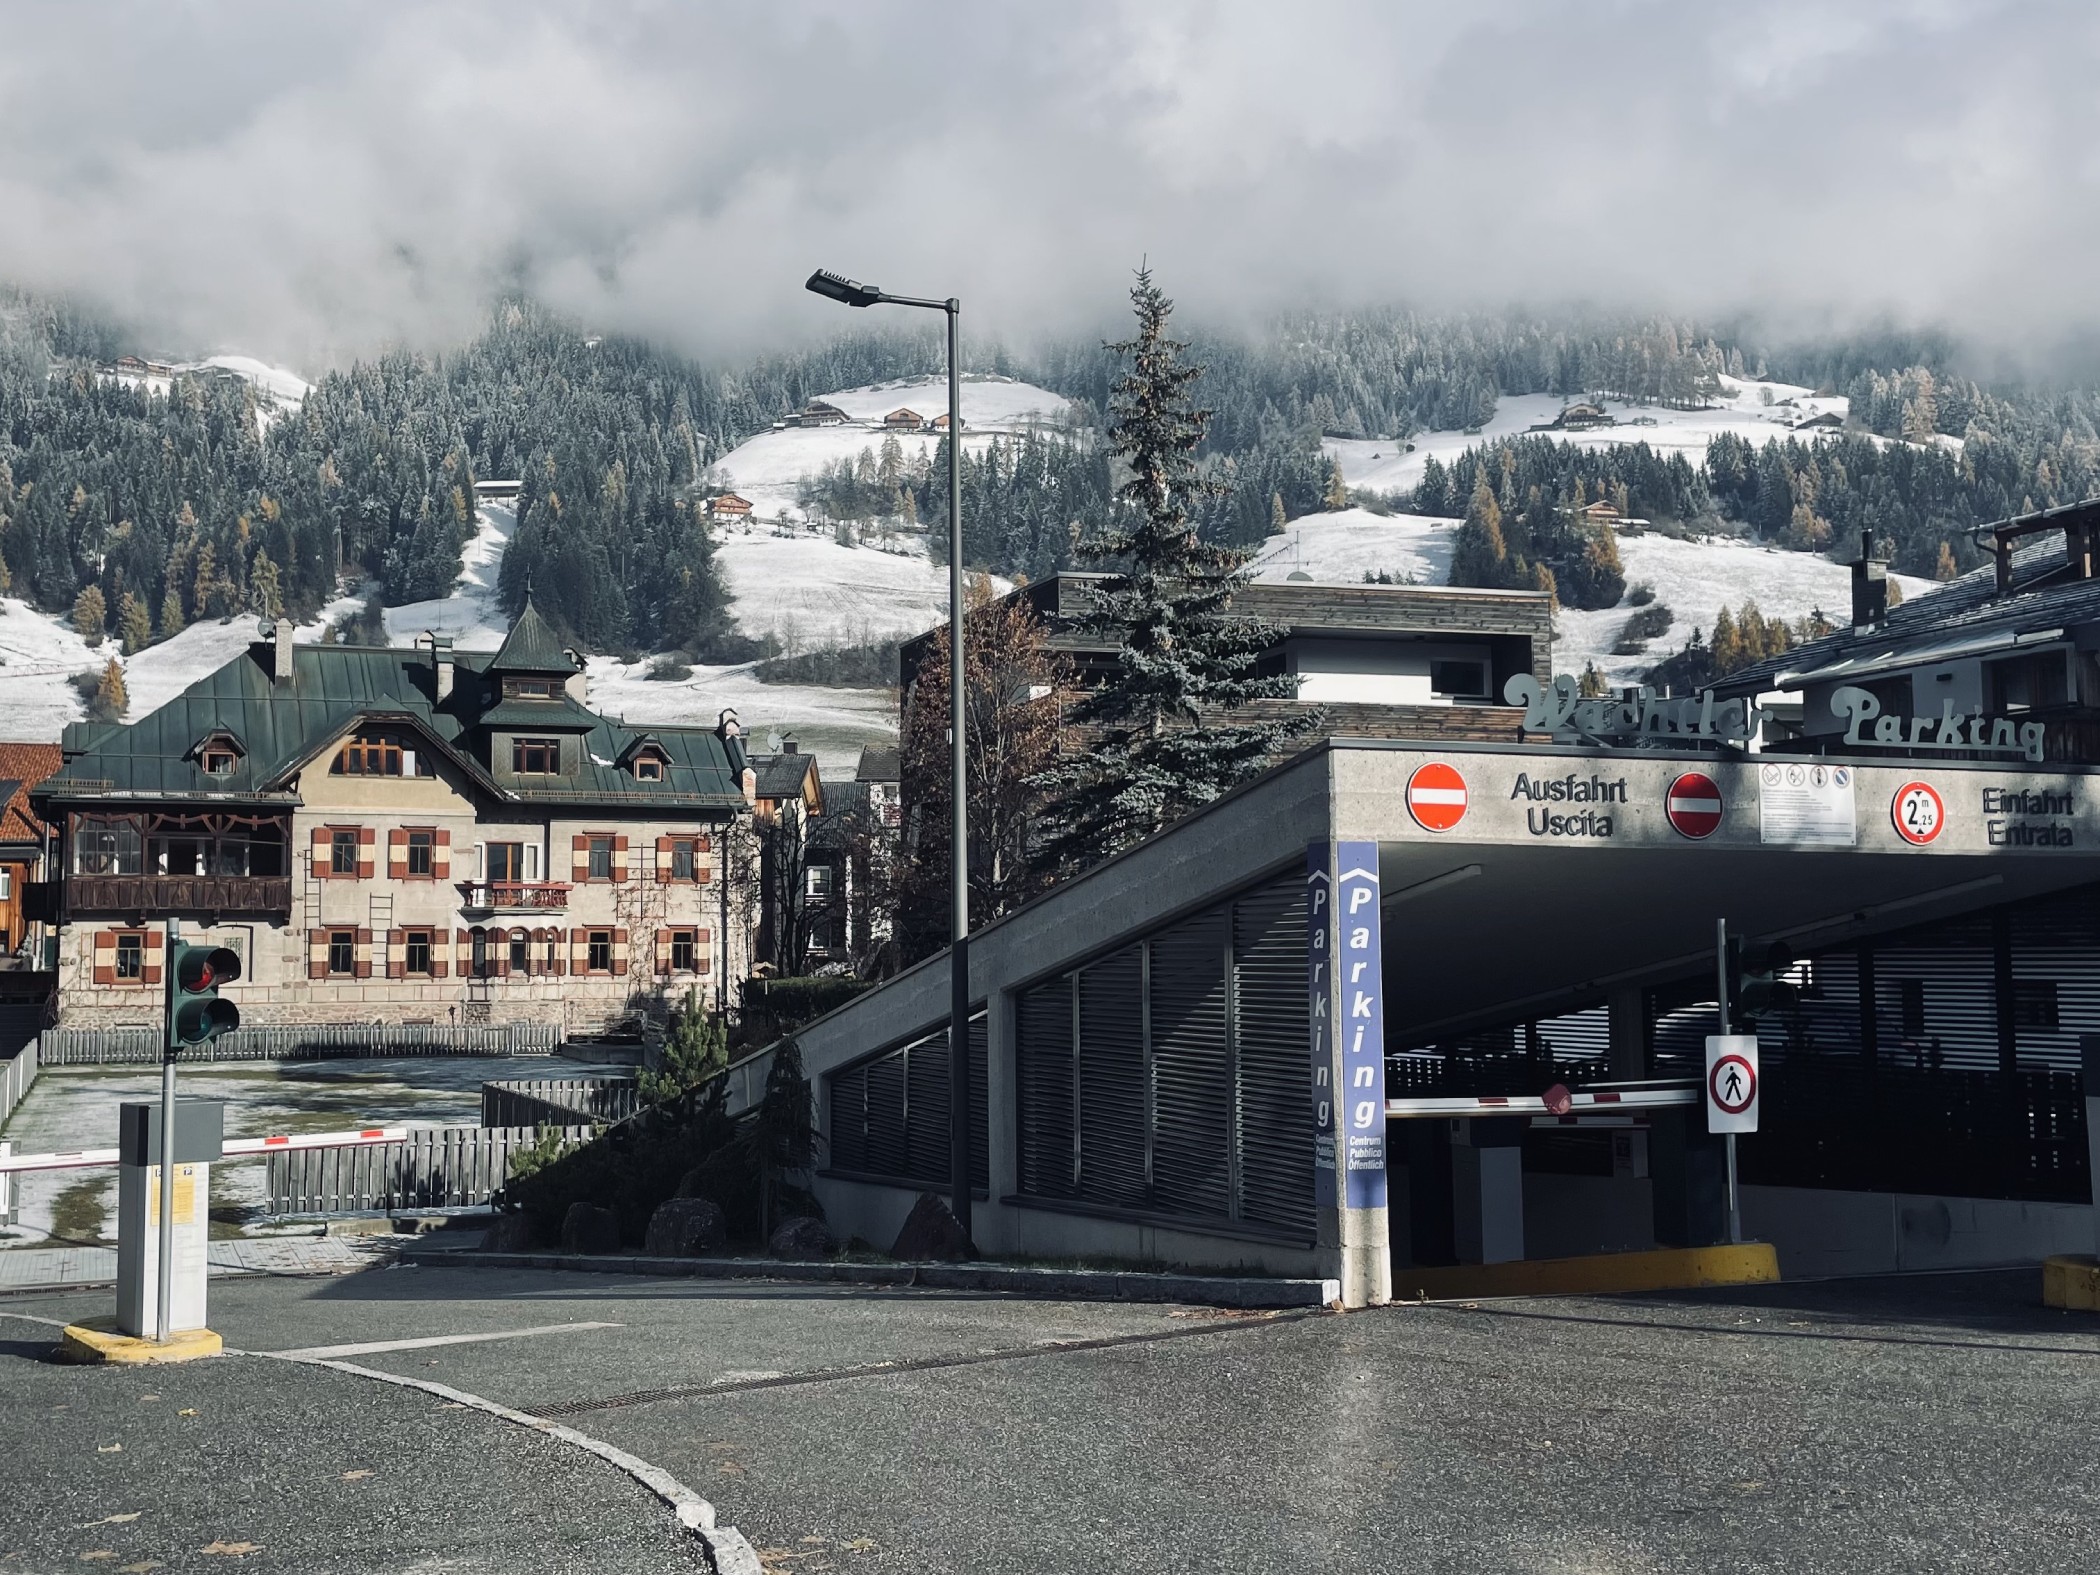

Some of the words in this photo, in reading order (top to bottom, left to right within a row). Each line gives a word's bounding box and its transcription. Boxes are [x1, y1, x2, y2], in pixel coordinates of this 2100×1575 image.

[1830, 686, 2045, 762] Parking
[1511, 773, 1628, 803] Ausfahrt
[1983, 787, 2074, 816] Einfahrt
[1527, 807, 1613, 837] Uscita
[1907, 799, 1918, 825] 2
[1921, 799, 1930, 808] m
[1988, 819, 2073, 847] Entrata
[1313, 888, 1330, 1128] Parking
[1349, 887, 1376, 1129] Parking
[1349, 1135, 1382, 1146] Centrum
[1349, 1147, 1382, 1158] Pubblico
